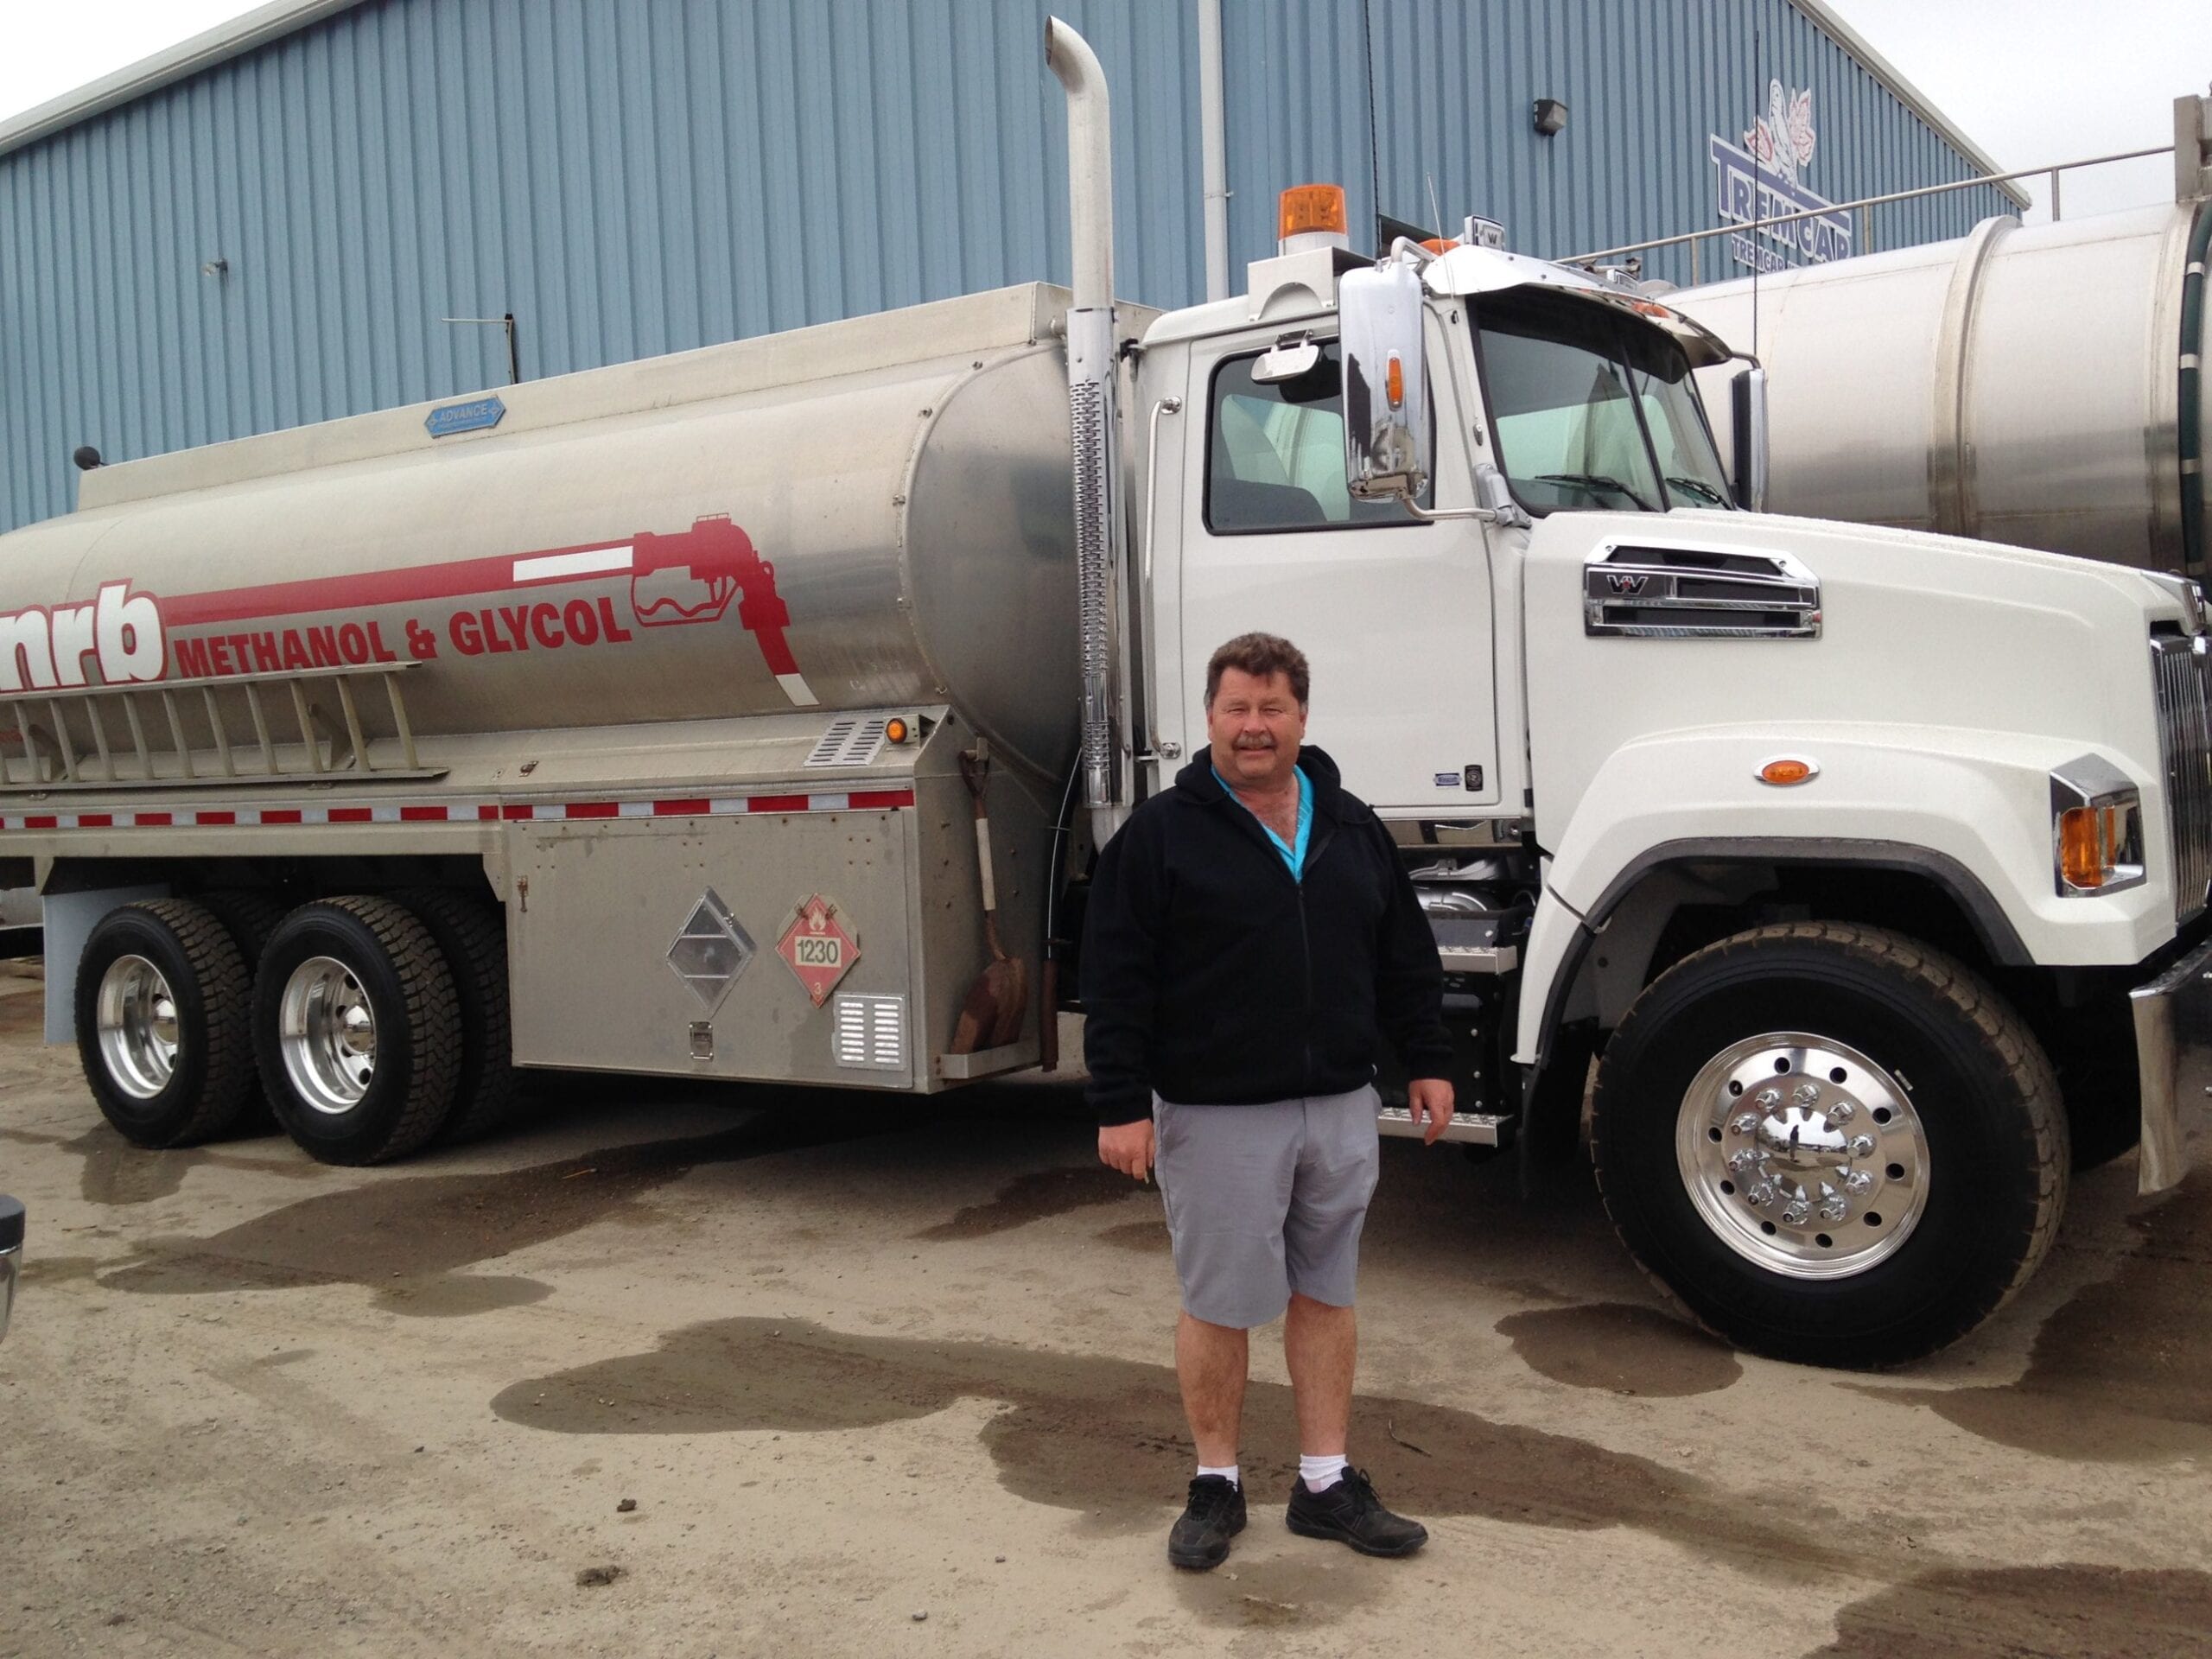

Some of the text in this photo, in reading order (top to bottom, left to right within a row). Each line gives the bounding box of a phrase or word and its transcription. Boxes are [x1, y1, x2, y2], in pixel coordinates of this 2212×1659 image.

[1711, 135, 1852, 261] TREMCAR
[439, 403, 488, 423] ADVANCE
[174, 597, 632, 678] METHANOL & GLYCOL
[798, 939, 838, 964] 1230
[814, 982, 823, 995] 3
